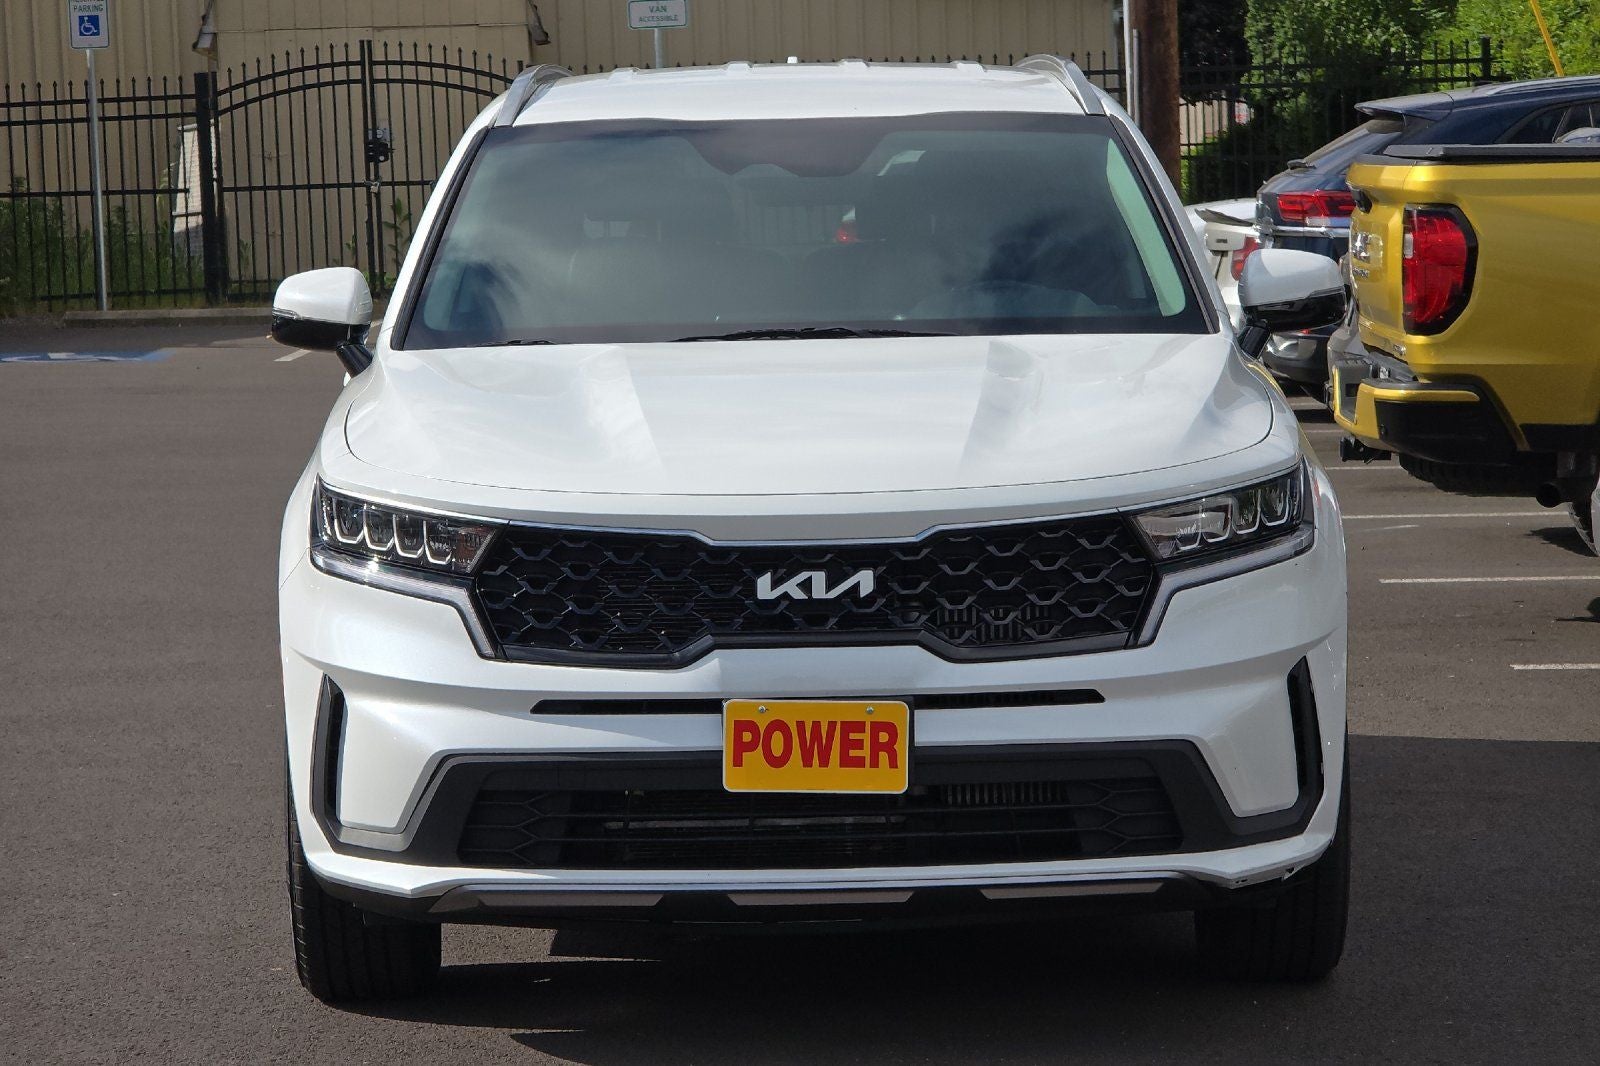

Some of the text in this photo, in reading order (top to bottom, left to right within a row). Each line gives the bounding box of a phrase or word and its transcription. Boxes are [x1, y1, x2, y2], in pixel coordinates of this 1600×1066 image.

[73, 4, 104, 12] PARKING
[649, 5, 668, 13] VAN
[757, 569, 874, 600] KIA
[732, 719, 899, 769] POWER
